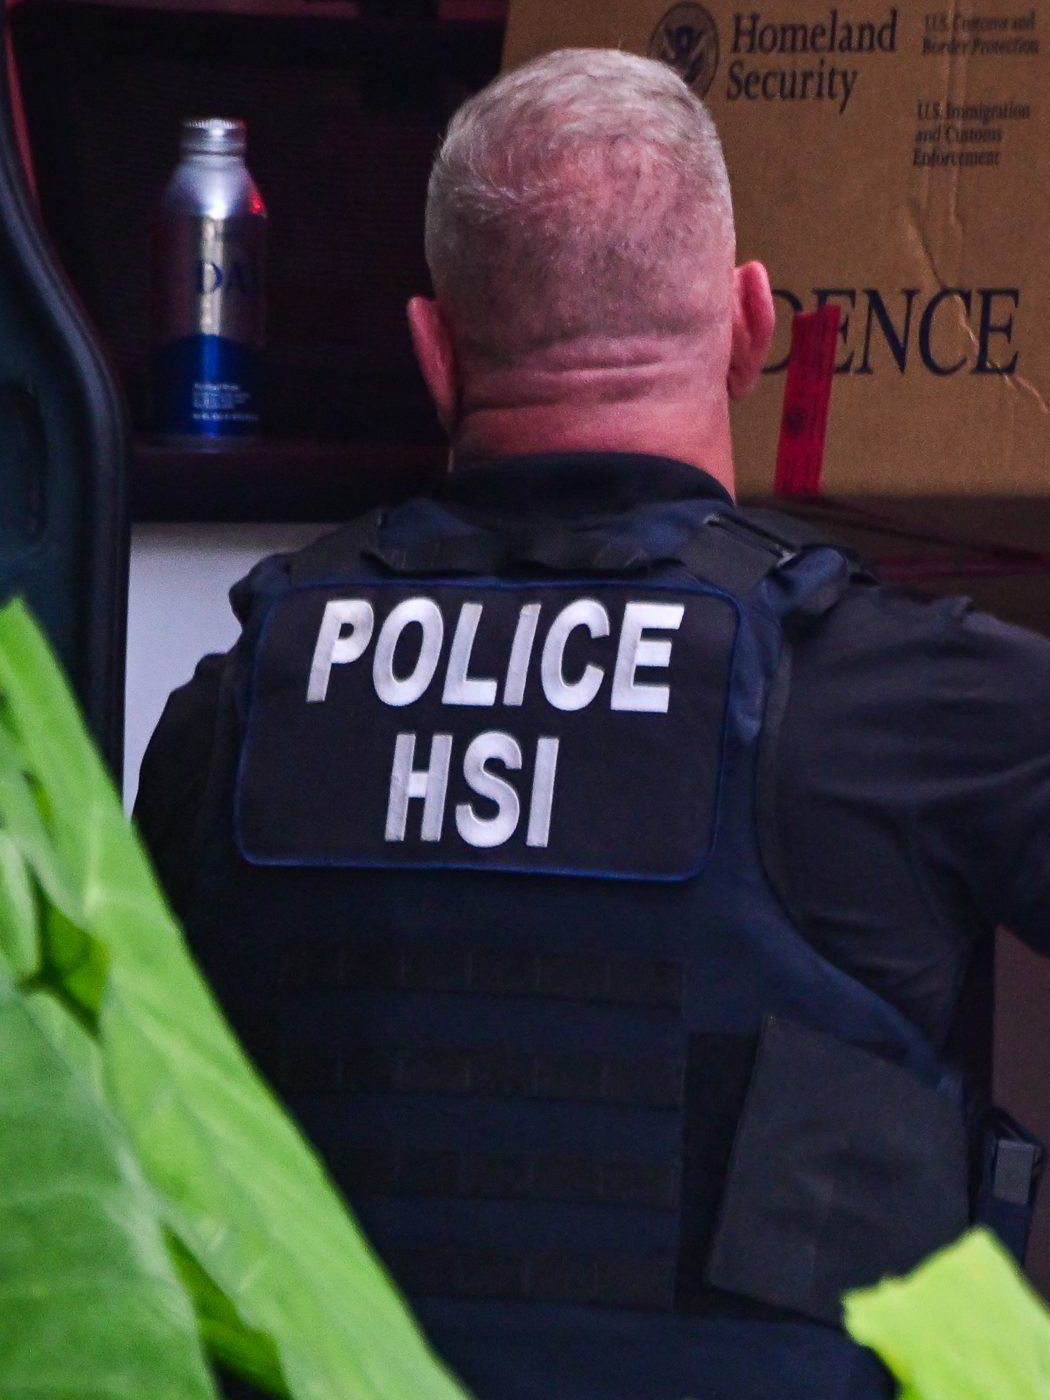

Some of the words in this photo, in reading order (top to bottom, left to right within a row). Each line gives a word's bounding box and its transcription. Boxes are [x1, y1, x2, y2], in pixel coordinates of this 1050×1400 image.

[731, 8, 899, 55] Homeland
[726, 59, 858, 115] Security
[914, 125, 941, 143] and
[946, 100, 1031, 125] Immigration
[912, 148, 1001, 167] Enforcement
[306, 596, 685, 713] POLICE
[384, 731, 560, 848] HSI
